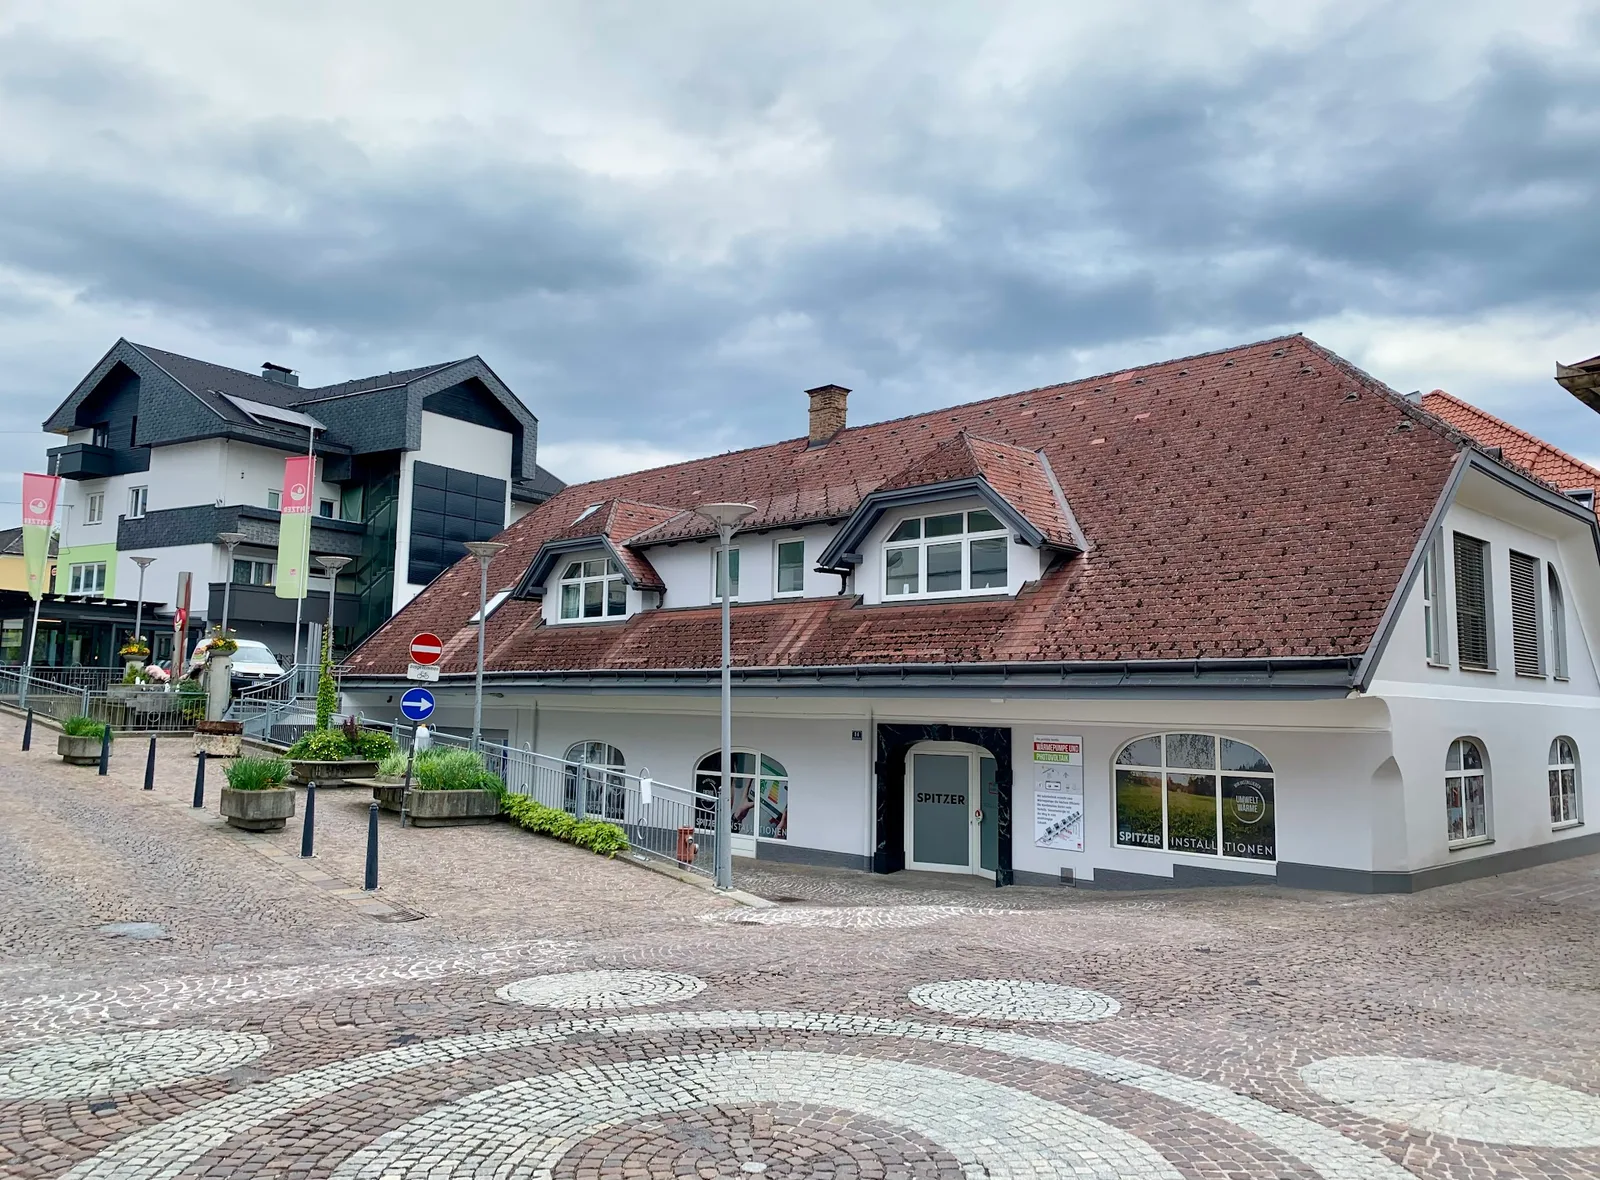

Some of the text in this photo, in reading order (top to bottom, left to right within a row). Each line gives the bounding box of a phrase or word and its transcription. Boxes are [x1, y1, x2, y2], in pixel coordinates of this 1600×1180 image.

[1036, 743, 1068, 752] WÄRMEPUMPE
[1036, 753, 1068, 761] PHOTOVOLTAIK
[917, 792, 965, 805] SPITZER
[1235, 795, 1259, 804] UMWELT
[1237, 803, 1258, 813] WÄRME
[1119, 831, 1273, 856] SPITZER INSTALLTIONEN
